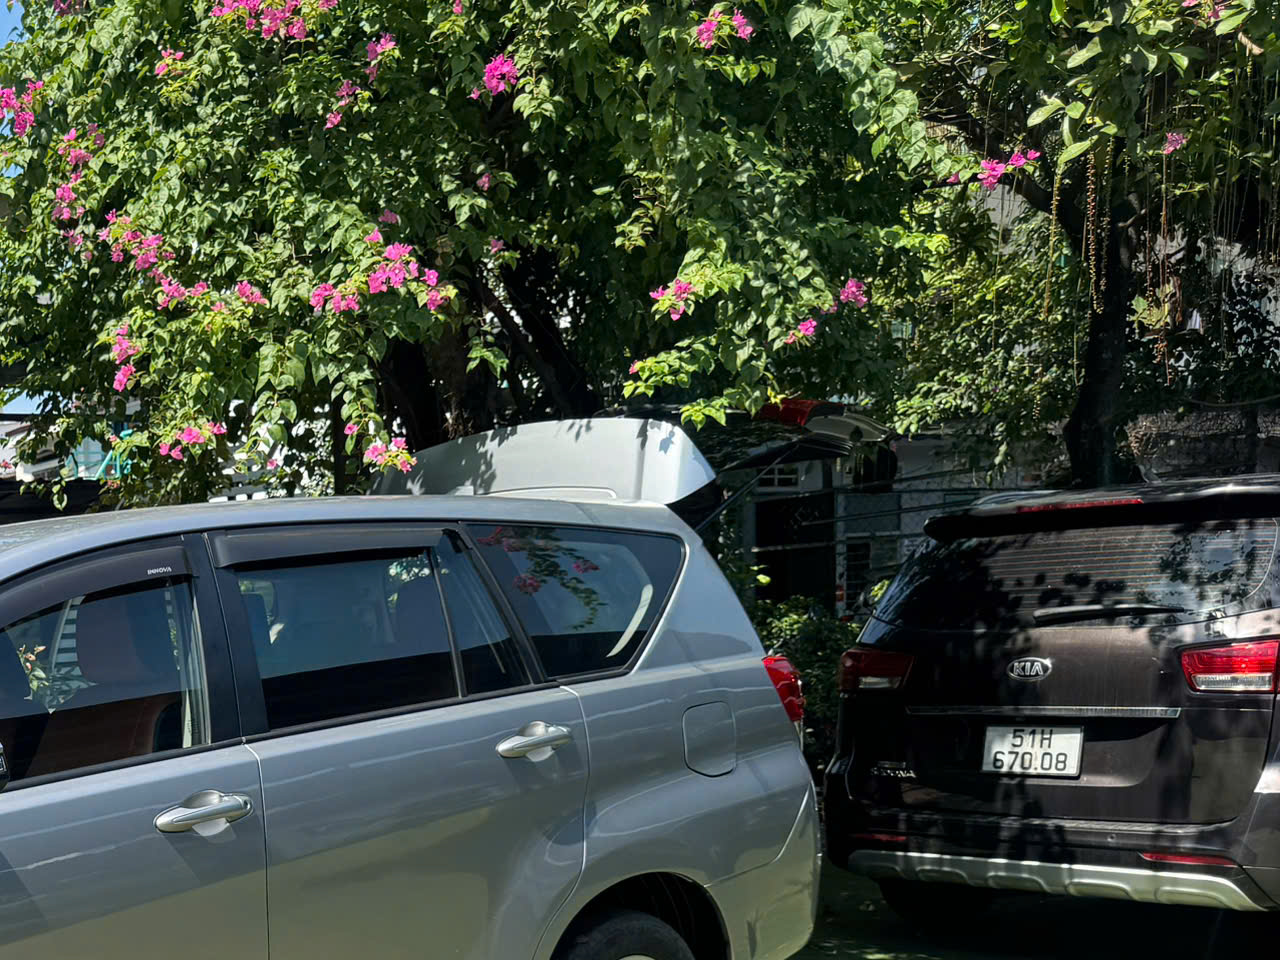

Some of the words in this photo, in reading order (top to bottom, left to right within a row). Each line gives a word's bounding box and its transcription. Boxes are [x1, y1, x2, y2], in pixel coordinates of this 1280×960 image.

[1013, 662, 1043, 675] KIA
[1011, 729, 1053, 748] 51H
[992, 751, 1068, 772] 670.08
